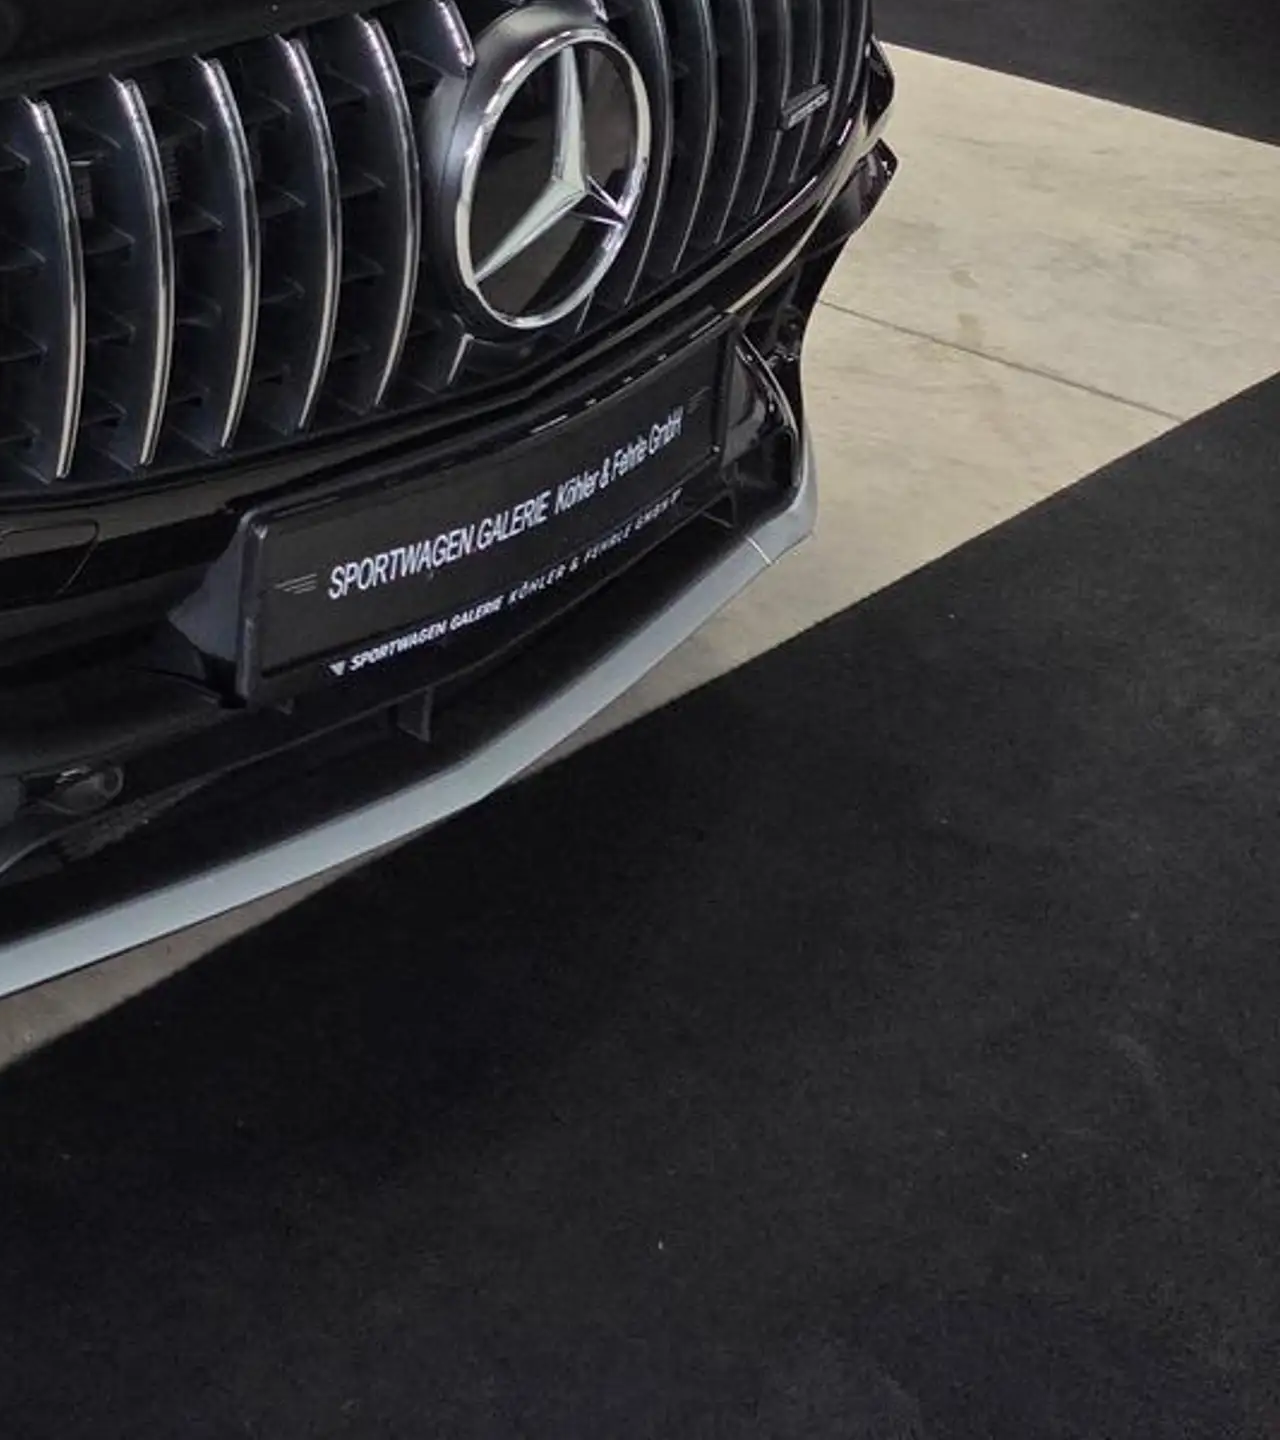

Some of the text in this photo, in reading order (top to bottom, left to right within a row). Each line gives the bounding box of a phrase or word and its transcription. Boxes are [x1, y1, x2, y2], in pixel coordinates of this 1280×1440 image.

[328, 523, 476, 601] SPORTWAGEN
[475, 490, 552, 551] GALERIE
[598, 457, 610, 489] &
[648, 404, 684, 456] GmbH
[349, 619, 449, 672] SPORTWAGEN
